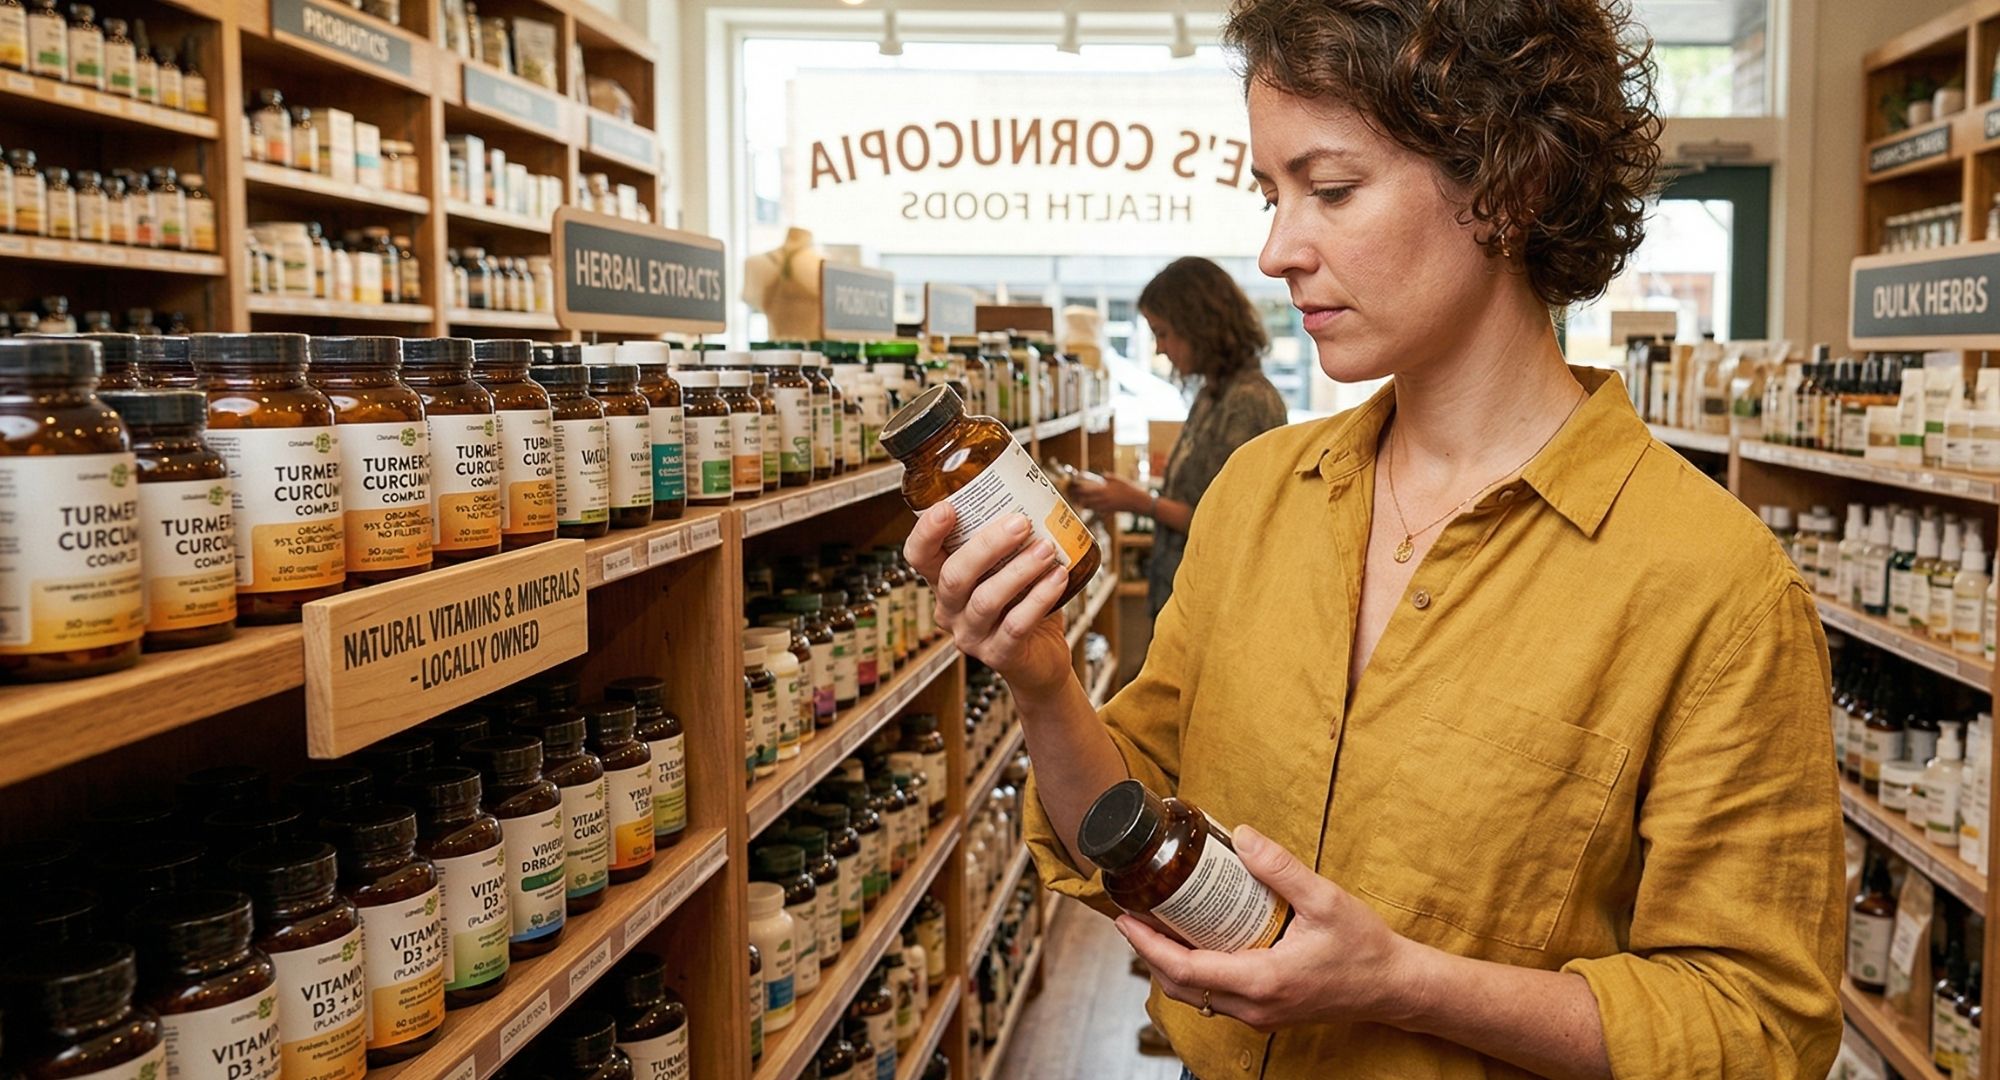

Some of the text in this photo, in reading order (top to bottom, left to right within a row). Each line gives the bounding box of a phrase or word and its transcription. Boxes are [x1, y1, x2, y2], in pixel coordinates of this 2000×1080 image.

[575, 248, 721, 301] HERBAL EXTRACTS
[1924, 275, 1989, 315] HERBS
[344, 567, 581, 671] NATURAL VITAMINS & MINERALS
[422, 636, 488, 690] LOCALLY
[491, 619, 539, 664] OWNED
[403, 946, 422, 965] D3
[313, 998, 336, 1018] D3
[227, 1059, 252, 1080] D3
